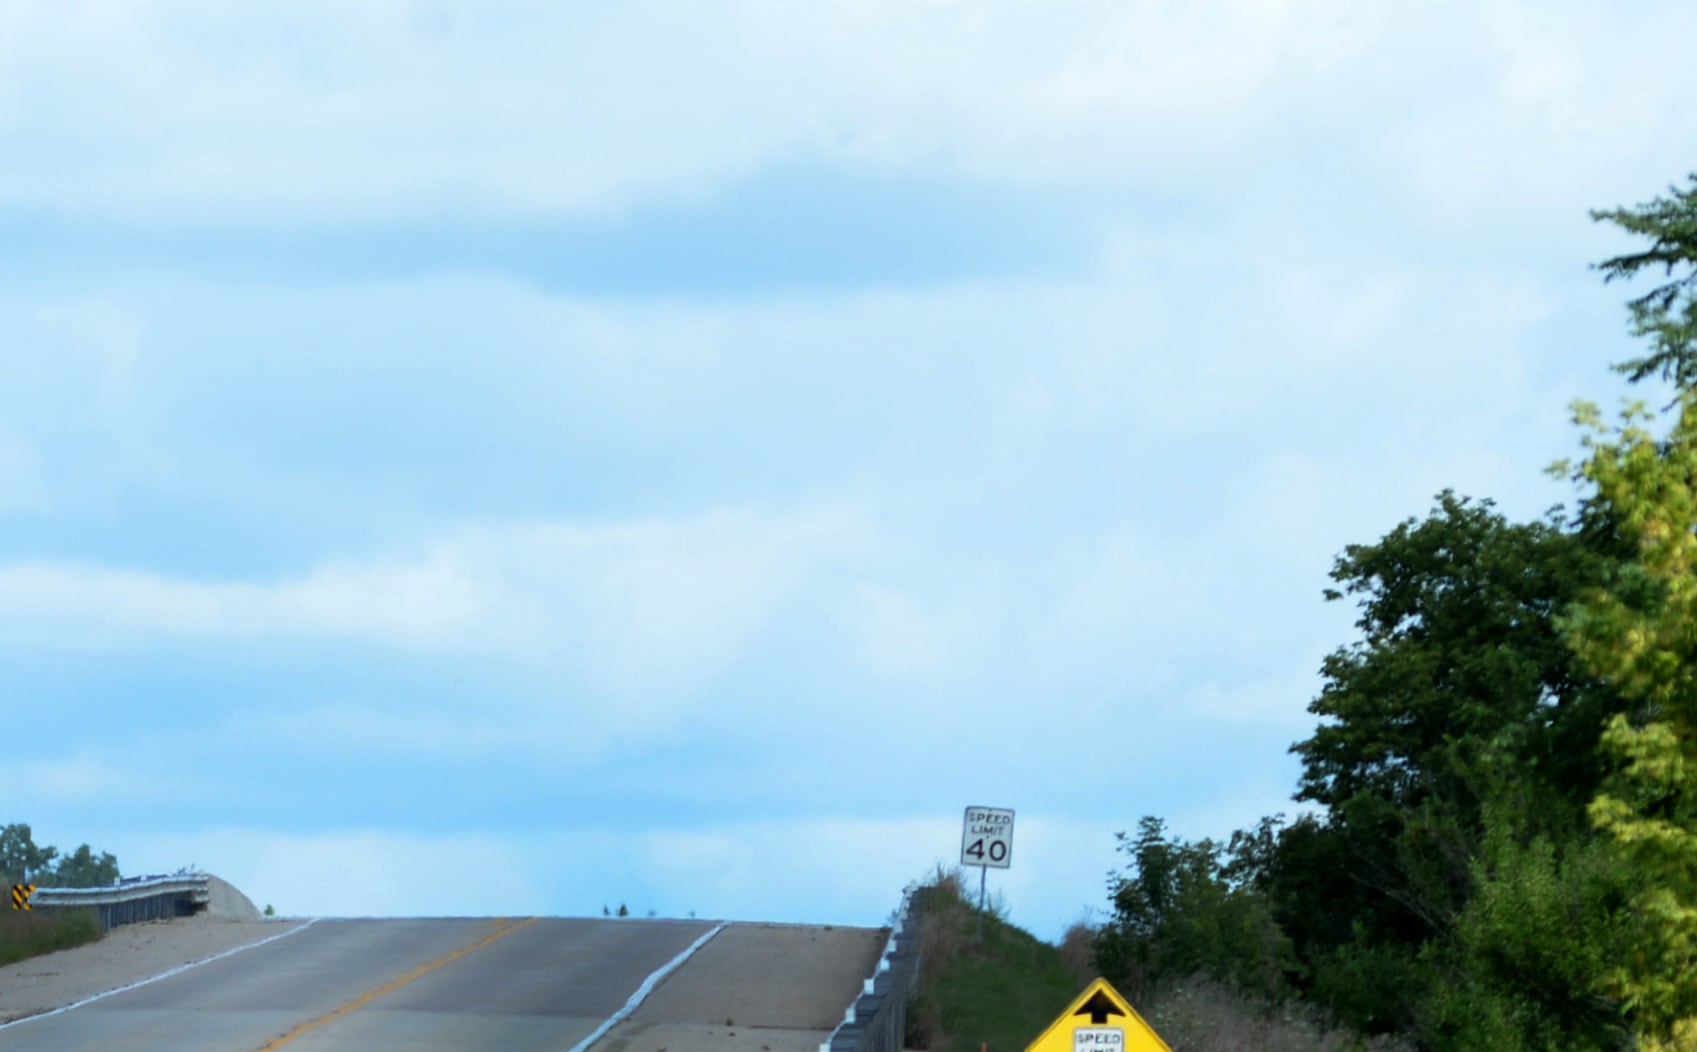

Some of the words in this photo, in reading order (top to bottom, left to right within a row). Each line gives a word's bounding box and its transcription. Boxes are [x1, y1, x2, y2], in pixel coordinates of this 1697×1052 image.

[968, 812, 1011, 824] SPEED
[971, 825, 1004, 835] LIMIT
[966, 838, 1006, 861] 40
[1077, 1033, 1120, 1044] SPEED
